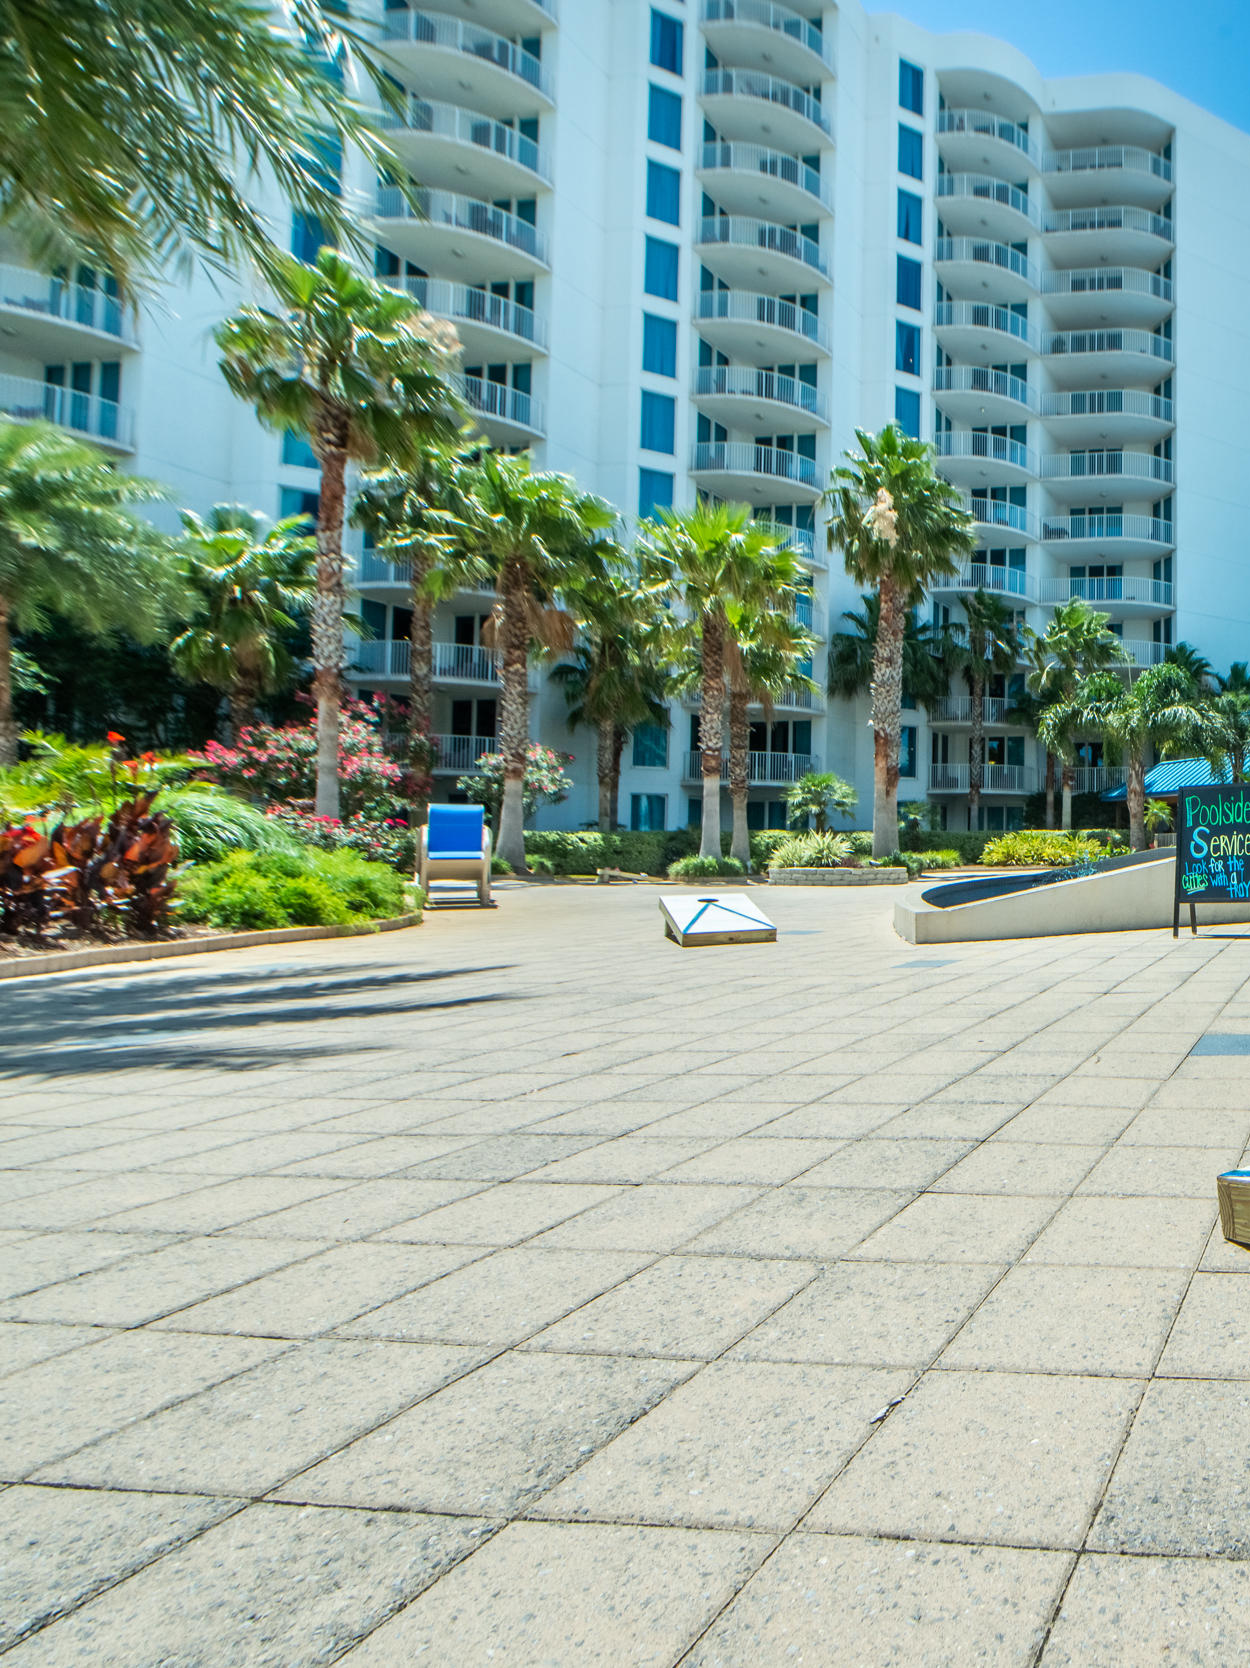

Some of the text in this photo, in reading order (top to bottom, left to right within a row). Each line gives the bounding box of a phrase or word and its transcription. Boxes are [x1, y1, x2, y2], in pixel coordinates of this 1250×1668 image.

[1185, 859, 1208, 876] Look
[1227, 856, 1244, 872] the
[1209, 872, 1228, 887] with
